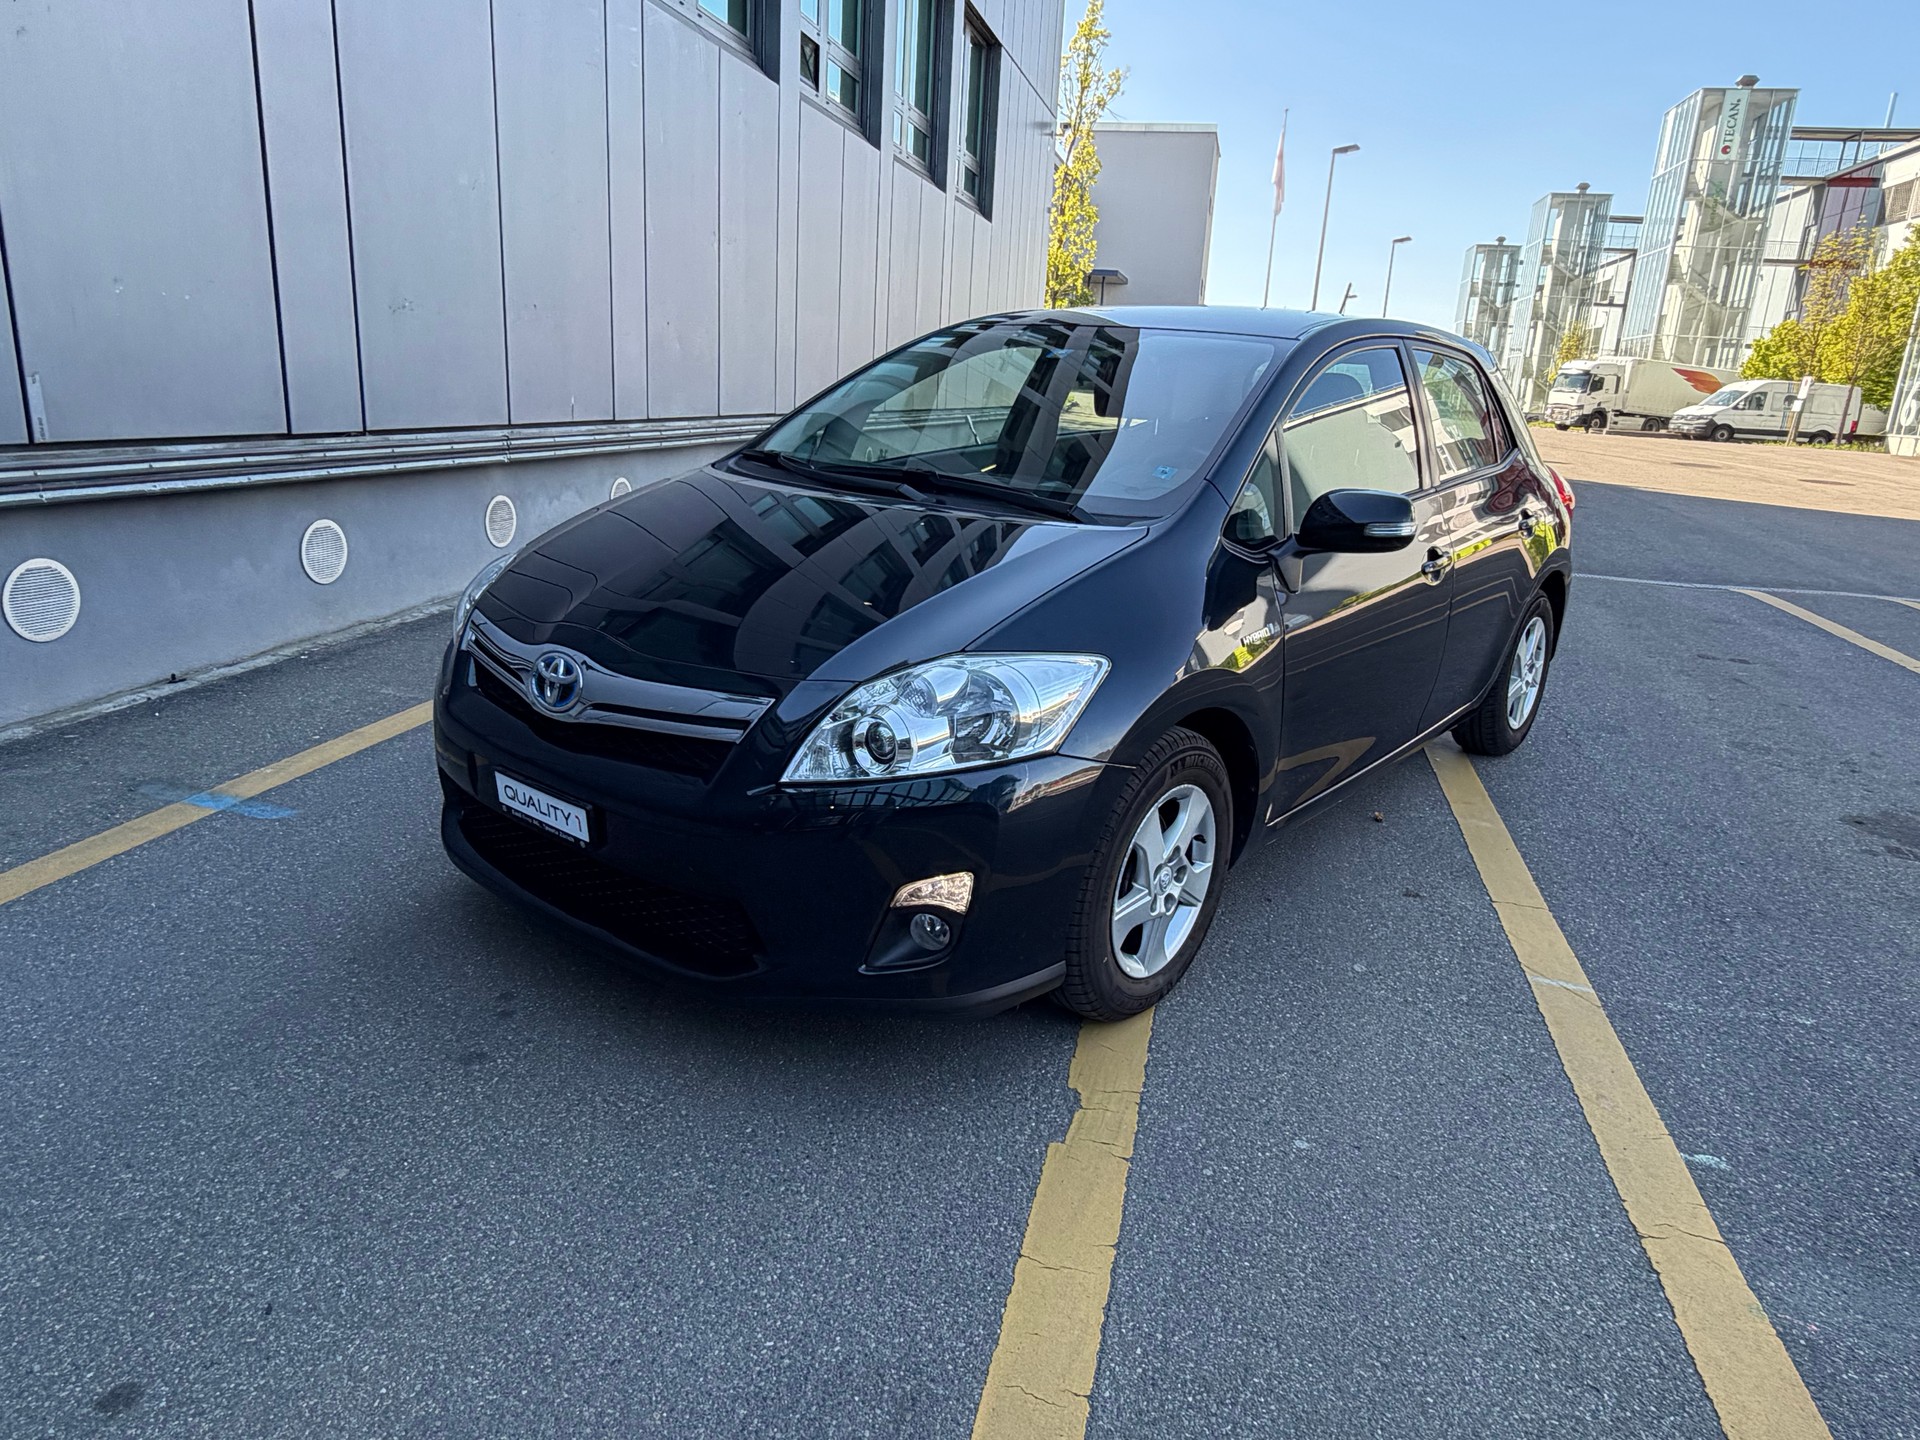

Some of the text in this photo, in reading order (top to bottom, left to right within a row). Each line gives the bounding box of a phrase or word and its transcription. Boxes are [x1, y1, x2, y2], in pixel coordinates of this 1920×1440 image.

[1243, 627, 1271, 646] HYBRID
[504, 785, 571, 826] QUALITY
[575, 814, 582, 833] 1
